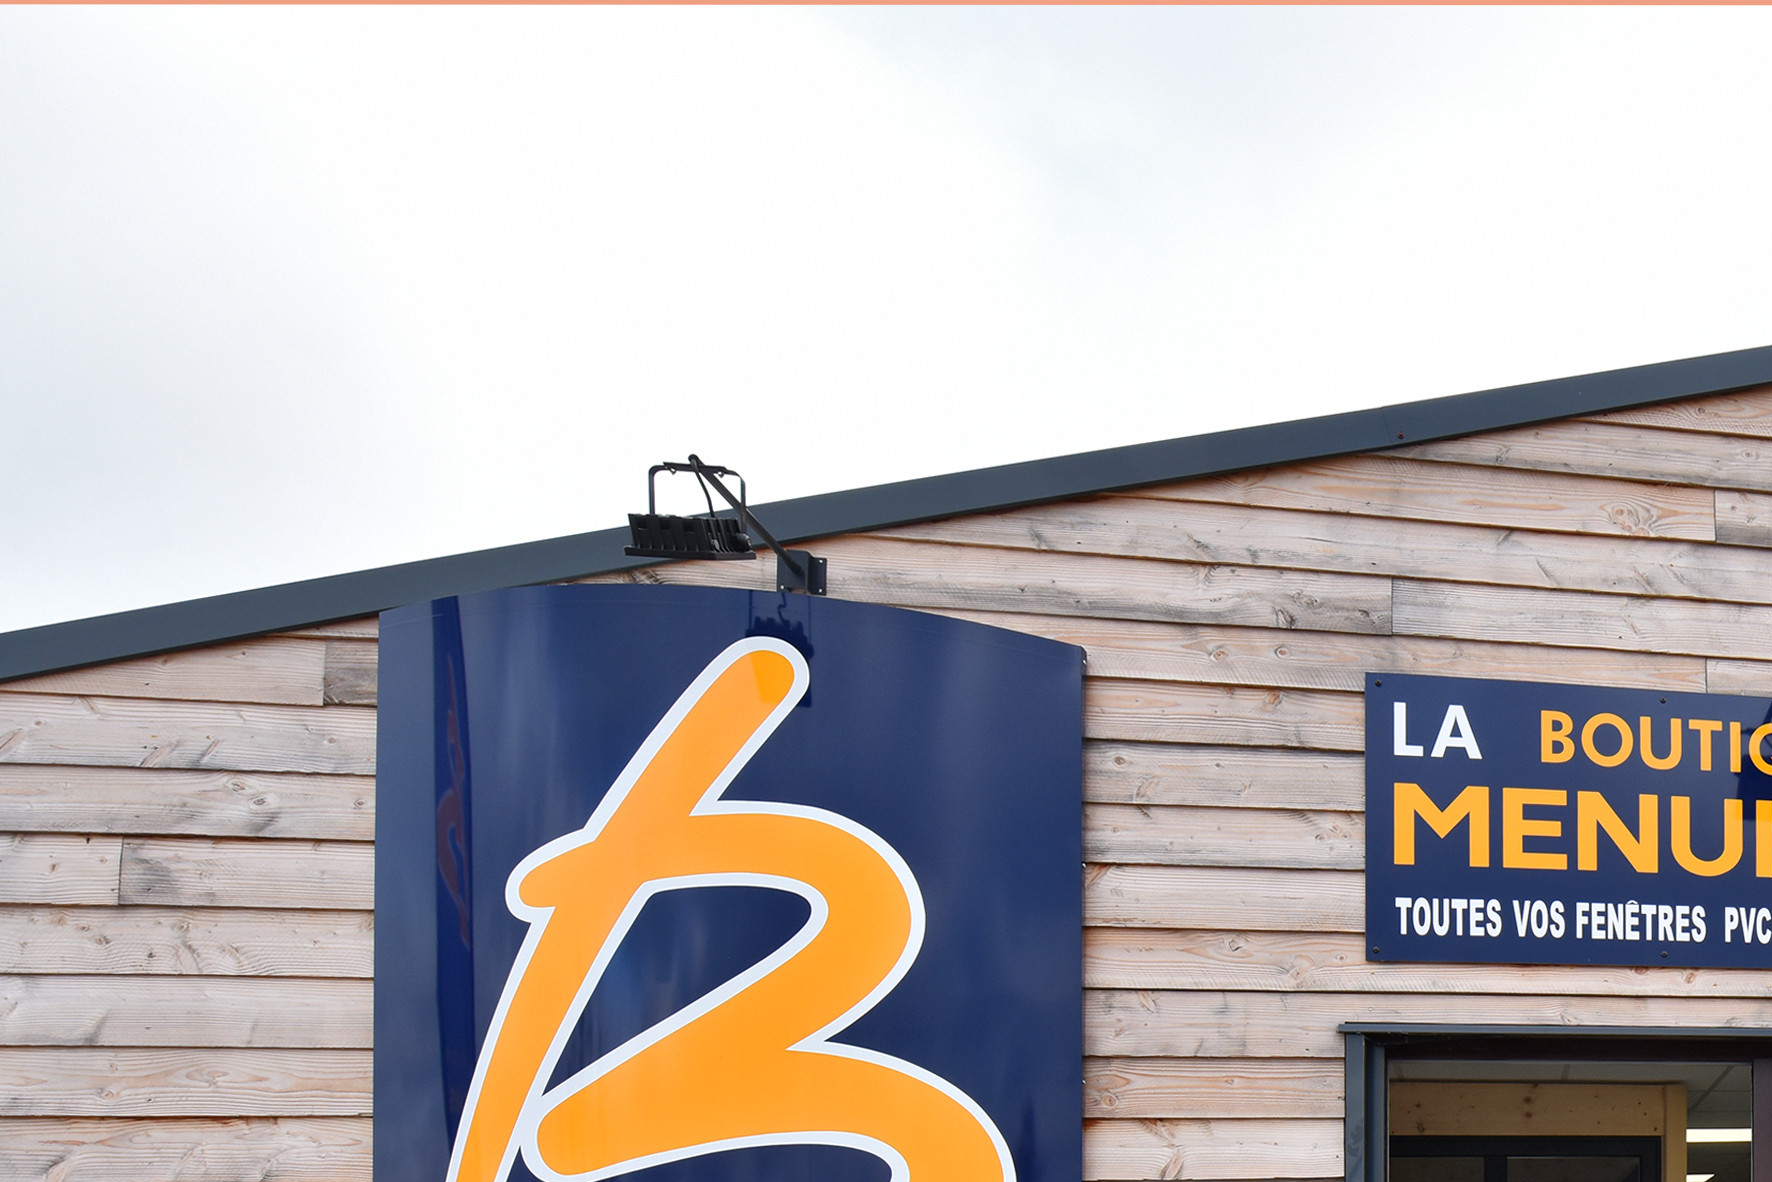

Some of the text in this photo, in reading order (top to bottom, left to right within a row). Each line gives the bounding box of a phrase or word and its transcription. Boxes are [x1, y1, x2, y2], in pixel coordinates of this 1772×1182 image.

[1393, 702, 1482, 760] LA
[1395, 897, 1502, 938] TOUTES
[1513, 900, 1566, 938] VOS
[1576, 900, 1707, 944] FENÊTRES
[1725, 907, 1772, 946] PVC
